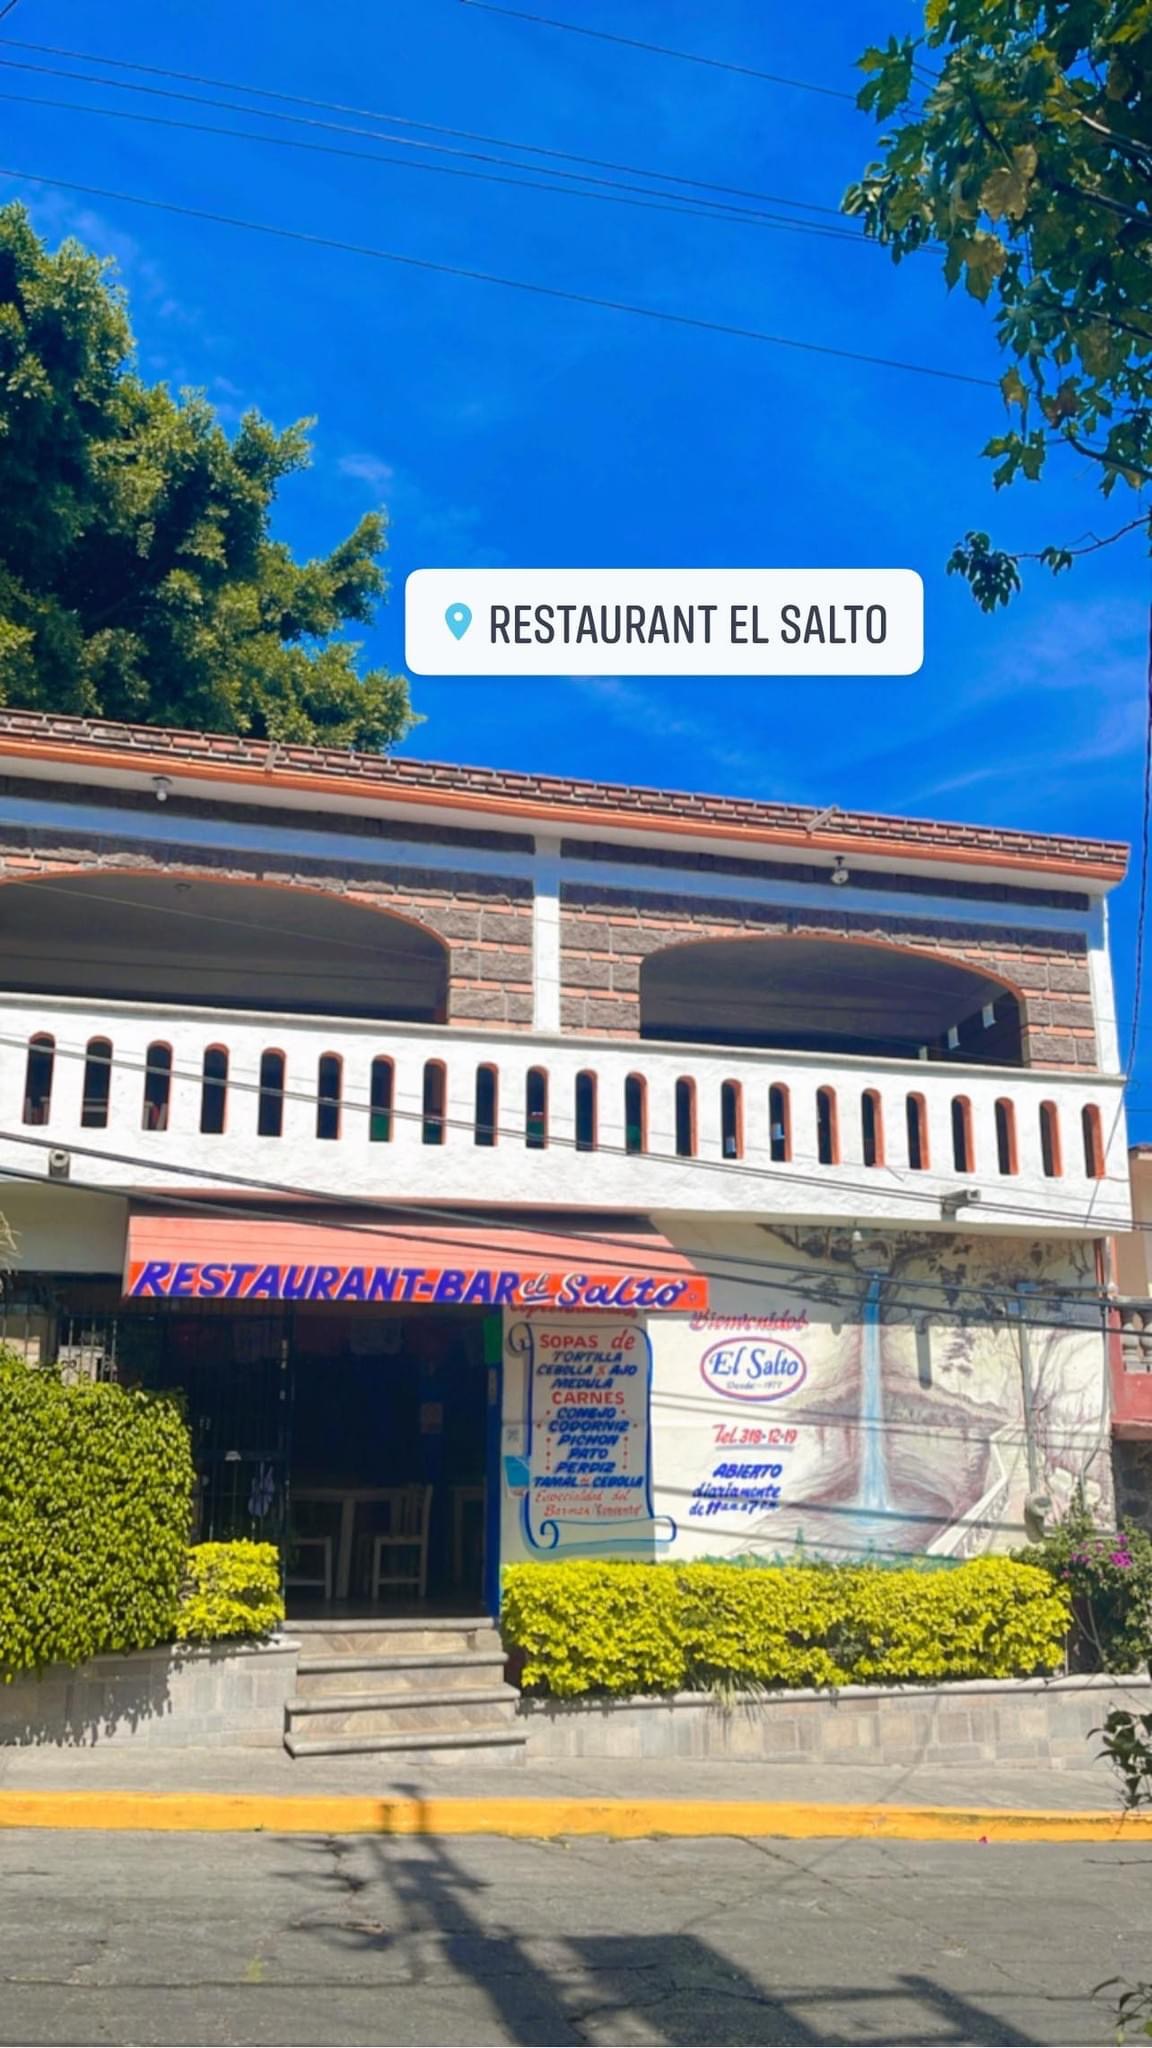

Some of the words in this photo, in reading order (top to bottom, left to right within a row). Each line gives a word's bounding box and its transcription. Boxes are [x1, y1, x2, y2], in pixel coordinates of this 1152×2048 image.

[130, 1261, 520, 1304] RESTAURANT-BAR
[555, 1272, 688, 1309] Salto
[539, 1333, 599, 1349] SOPAS
[611, 1328, 636, 1350] de
[552, 1351, 623, 1362] TORTILLA
[709, 1346, 746, 1376] El
[747, 1349, 799, 1379] Salto
[536, 1364, 593, 1375] CEBOLLA
[609, 1364, 638, 1376] AJO
[551, 1377, 614, 1389] MEDULA
[552, 1391, 625, 1405] CARNES
[556, 1407, 617, 1420] CONEJO
[547, 1420, 630, 1433] CODORNIZ
[556, 1434, 620, 1446] PICHON
[567, 1448, 609, 1460] PATO
[554, 1461, 616, 1474] PERDIZ
[712, 1463, 783, 1479] ABIERTO
[533, 1476, 578, 1488] TAMAL
[592, 1476, 645, 1488] CEBOLLA
